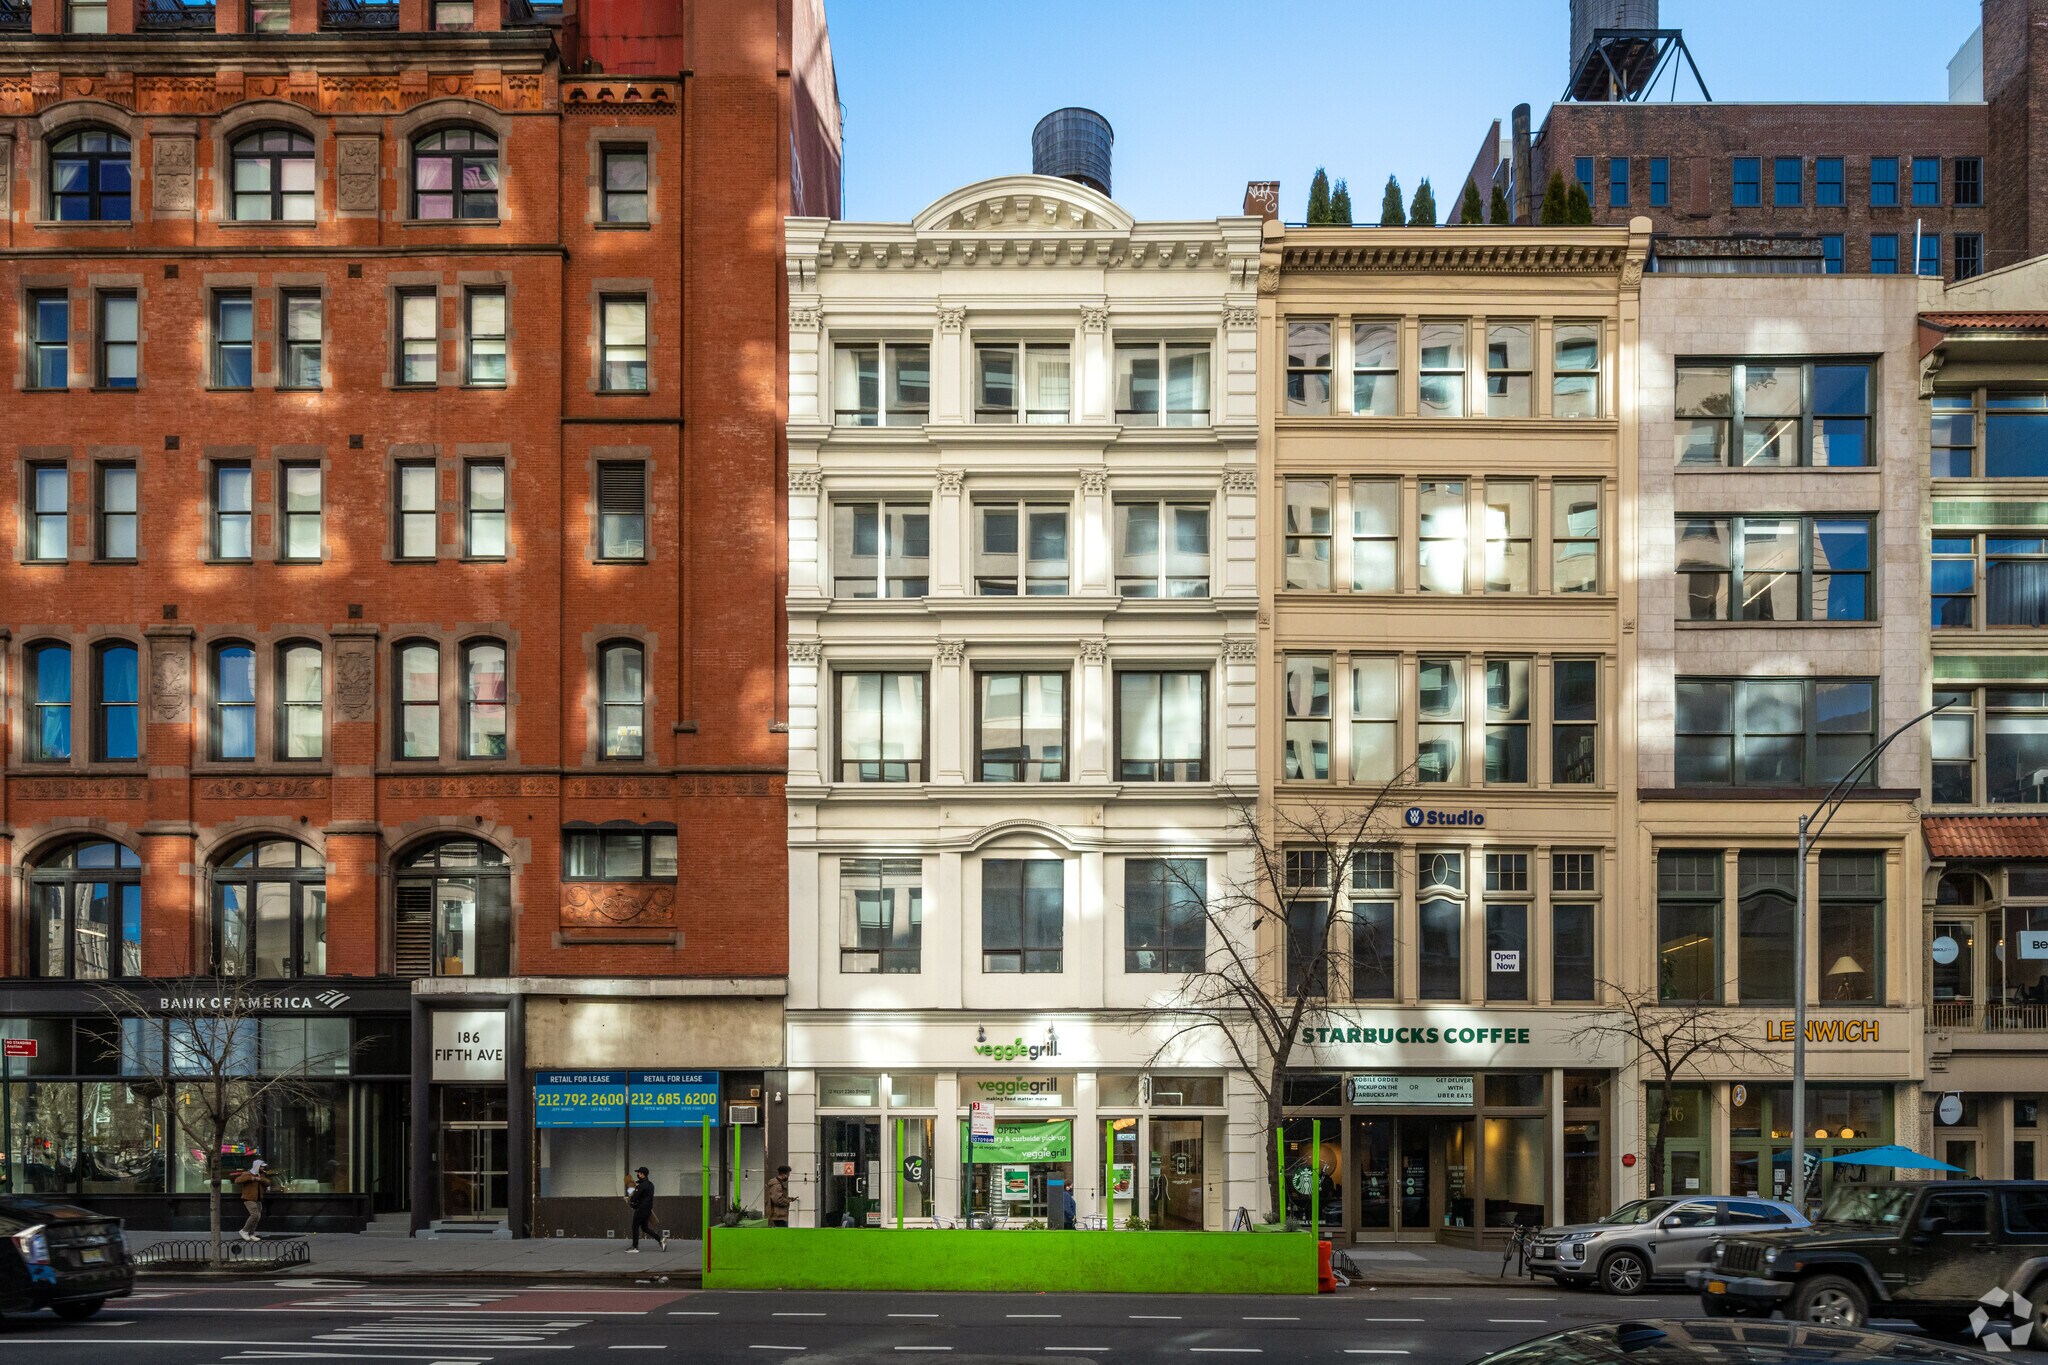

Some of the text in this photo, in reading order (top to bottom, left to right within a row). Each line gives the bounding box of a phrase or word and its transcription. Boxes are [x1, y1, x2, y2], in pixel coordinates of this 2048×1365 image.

[1427, 810, 1484, 825] Studio
[1494, 952, 1516, 961] Open
[1496, 962, 1515, 970] Now
[160, 997, 313, 1009] BANK OF AMERICA
[457, 1031, 480, 1043] 186
[1302, 1027, 1530, 1044] STARBUCKS COFFEE
[1767, 1020, 1880, 1042] LENWICH
[435, 1049, 502, 1061] FIFTH AVE
[974, 1038, 1058, 1060] veggiegrill
[550, 1075, 610, 1083] RETAIL FOR LEASE
[643, 1075, 703, 1083] RETAIL FOR LEASE
[976, 1076, 1057, 1095] veggiegrill
[538, 1093, 624, 1106] 212.792.2600
[631, 1093, 717, 1105] 212.685.6200
[1668, 1106, 1684, 1121] 16
[1041, 1134, 1067, 1143] pick-up
[1021, 1147, 1067, 1159] veggiegrill
